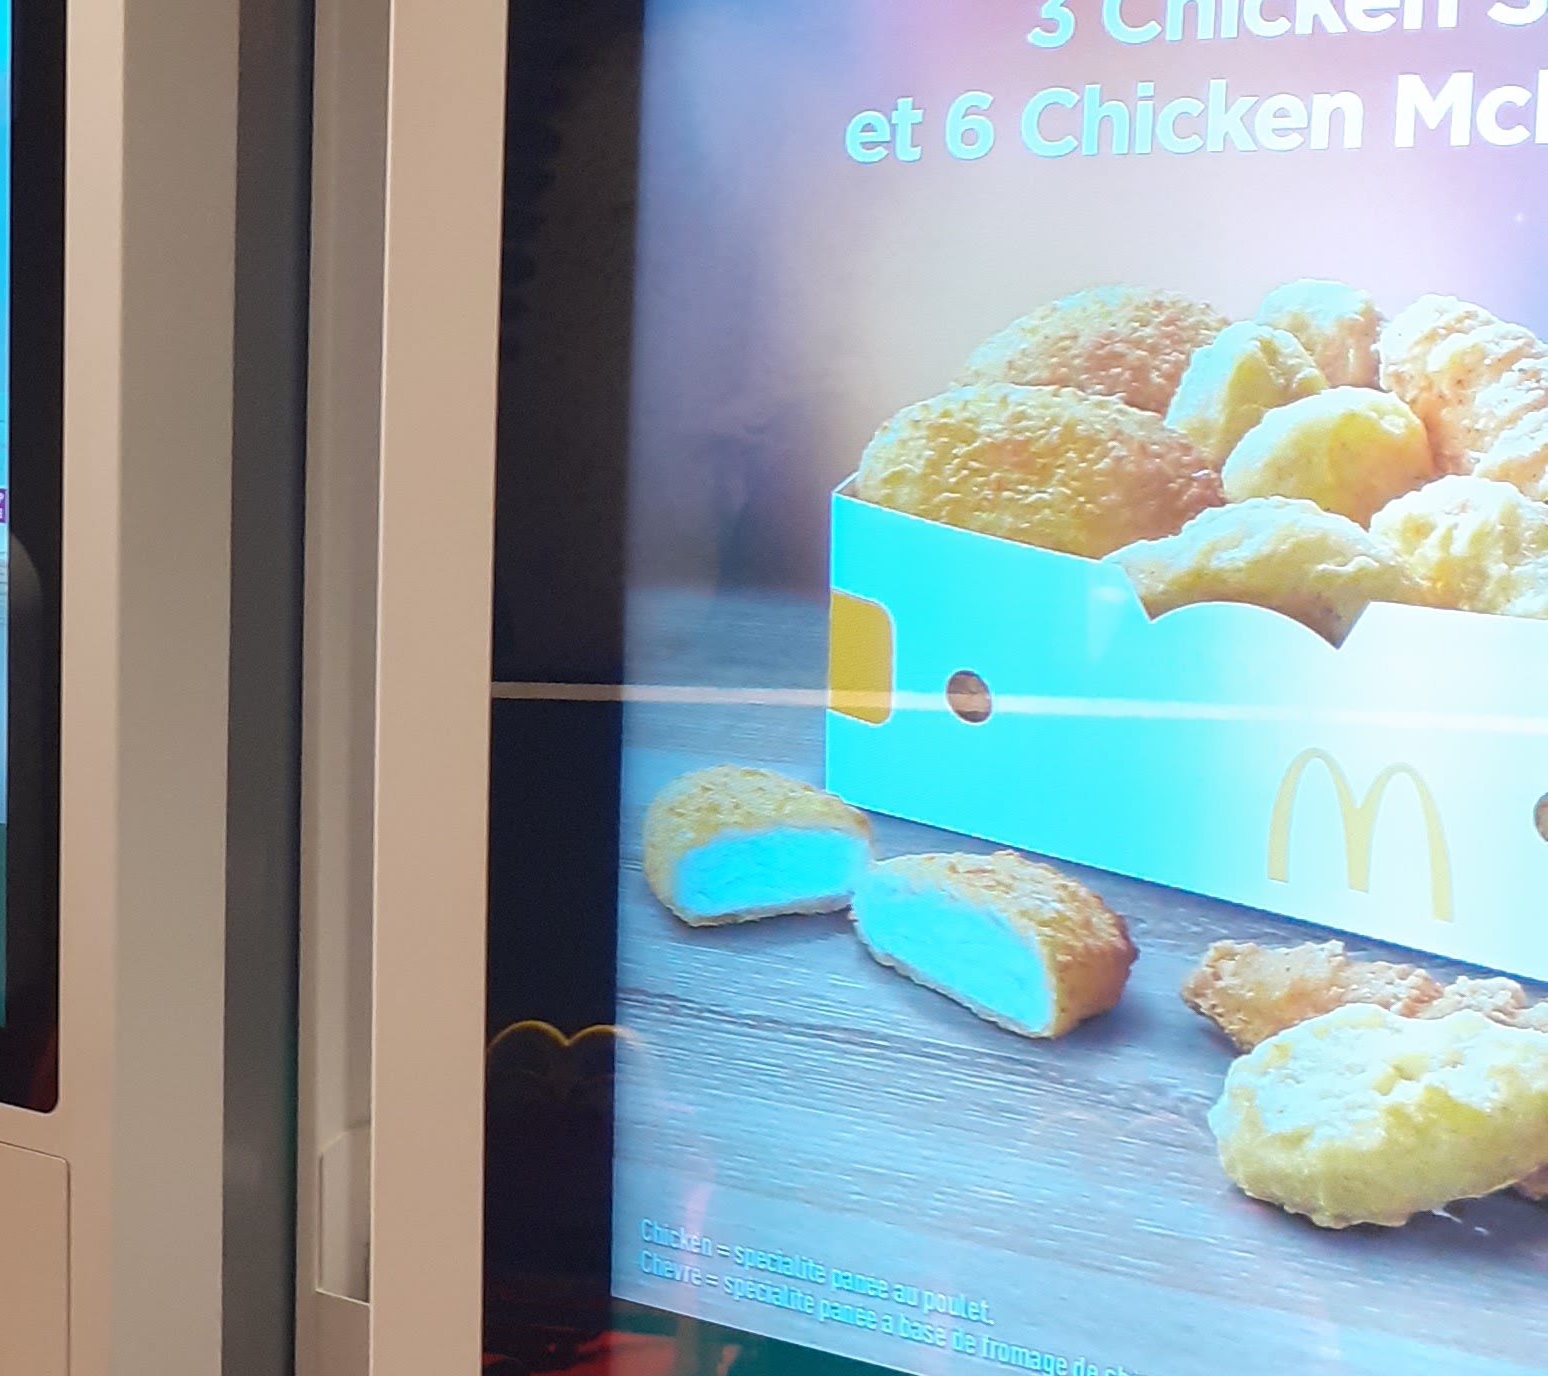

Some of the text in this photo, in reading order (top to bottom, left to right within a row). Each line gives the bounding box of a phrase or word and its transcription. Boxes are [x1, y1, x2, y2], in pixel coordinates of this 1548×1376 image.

[844, 69, 1548, 163] et 6 Chicken Mc
[640, 1218, 713, 1257] Chicken
